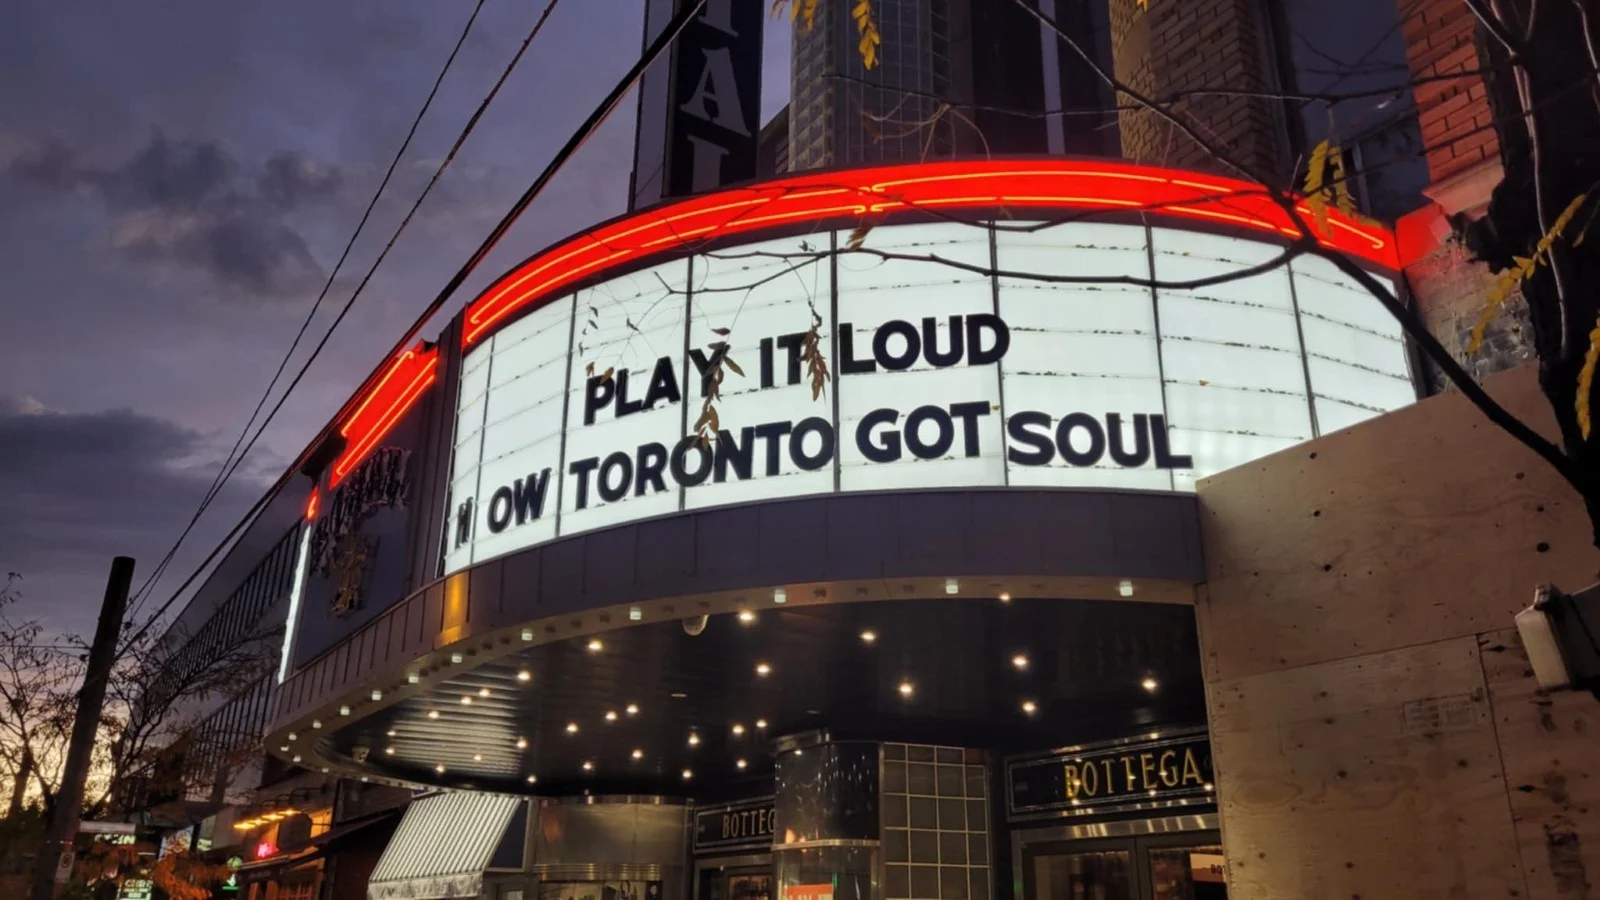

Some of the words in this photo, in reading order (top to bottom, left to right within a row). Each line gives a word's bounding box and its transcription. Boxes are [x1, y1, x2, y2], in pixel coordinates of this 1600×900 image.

[583, 342, 731, 426] PLAY
[760, 332, 813, 389] IT
[839, 313, 1010, 375] LOUD
[569, 417, 835, 510] TORONTO
[855, 401, 991, 464] GOT
[1007, 410, 1193, 469] SOUL
[1064, 749, 1204, 798] BOTTEGA
